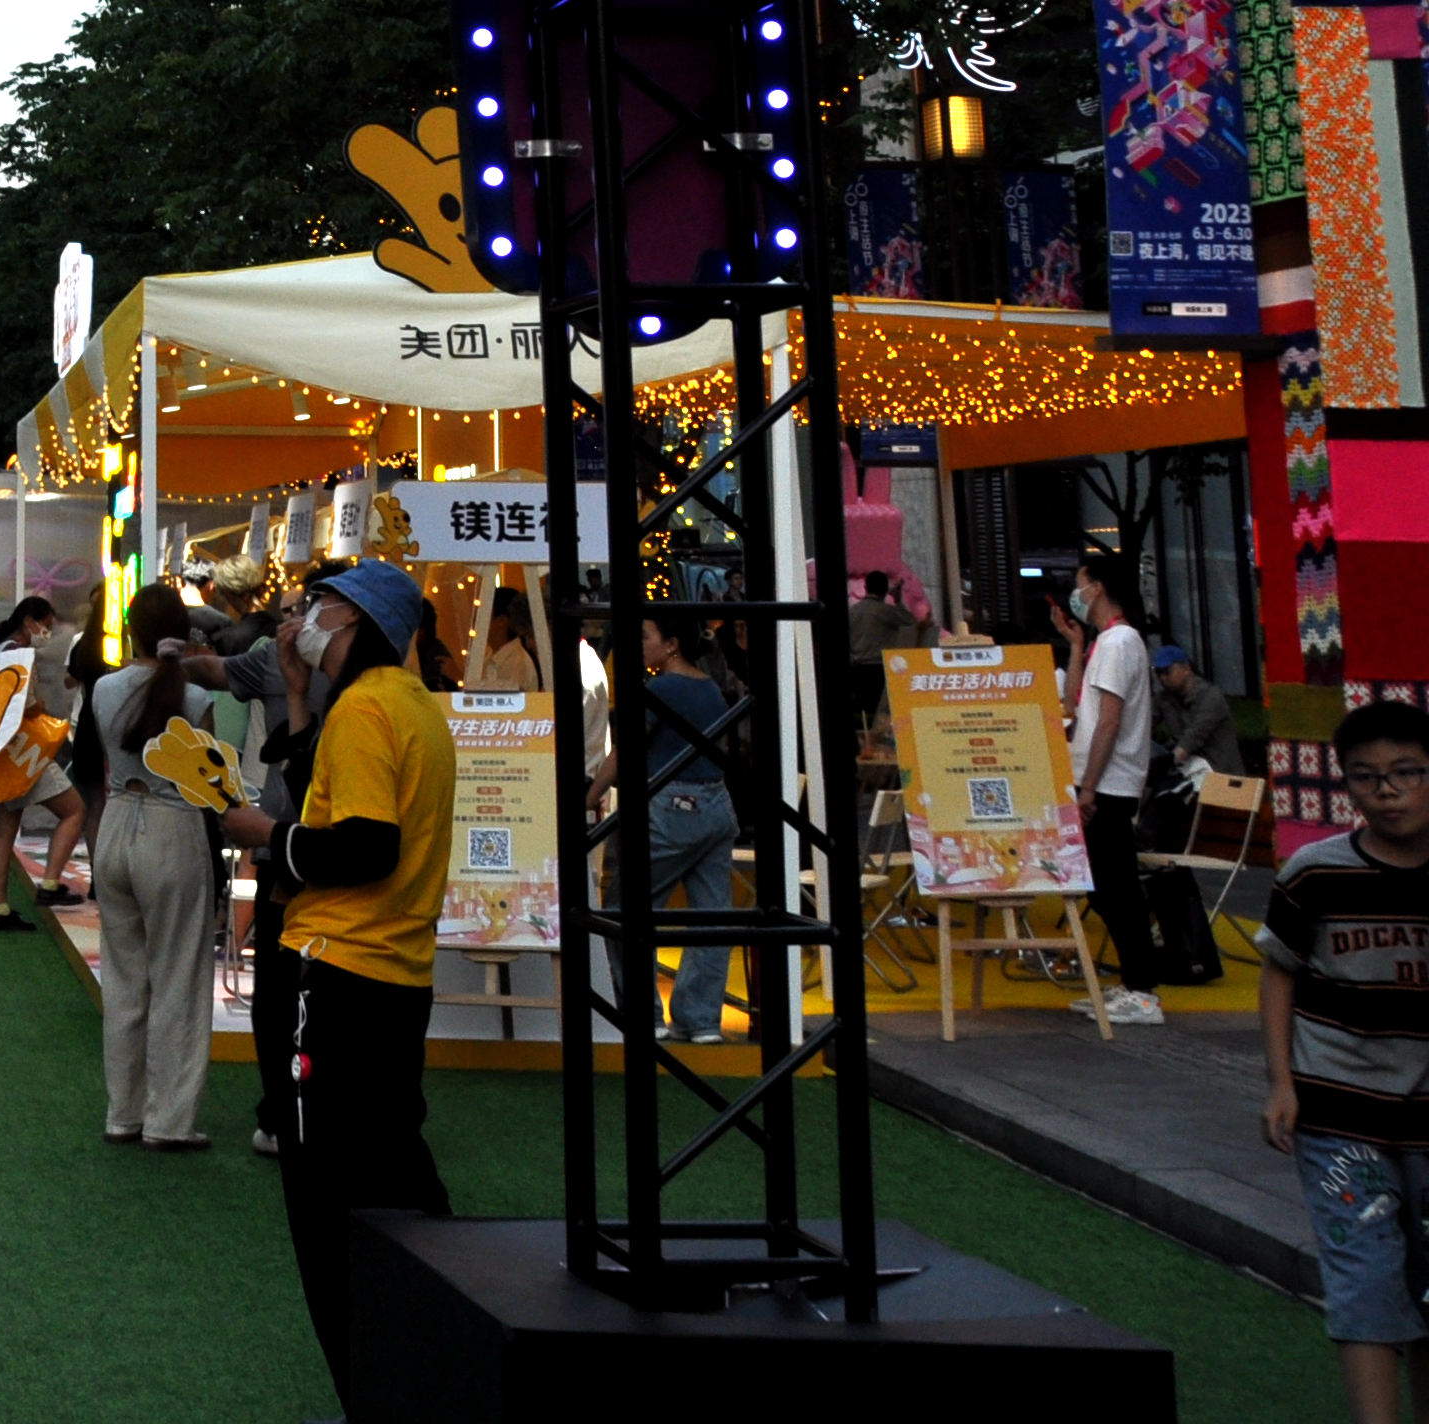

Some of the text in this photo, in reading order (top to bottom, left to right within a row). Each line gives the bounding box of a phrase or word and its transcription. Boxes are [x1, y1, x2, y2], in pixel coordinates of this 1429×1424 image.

[1200, 203, 1252, 224] 2023
[911, 671, 1034, 692] 美好生活小集市
